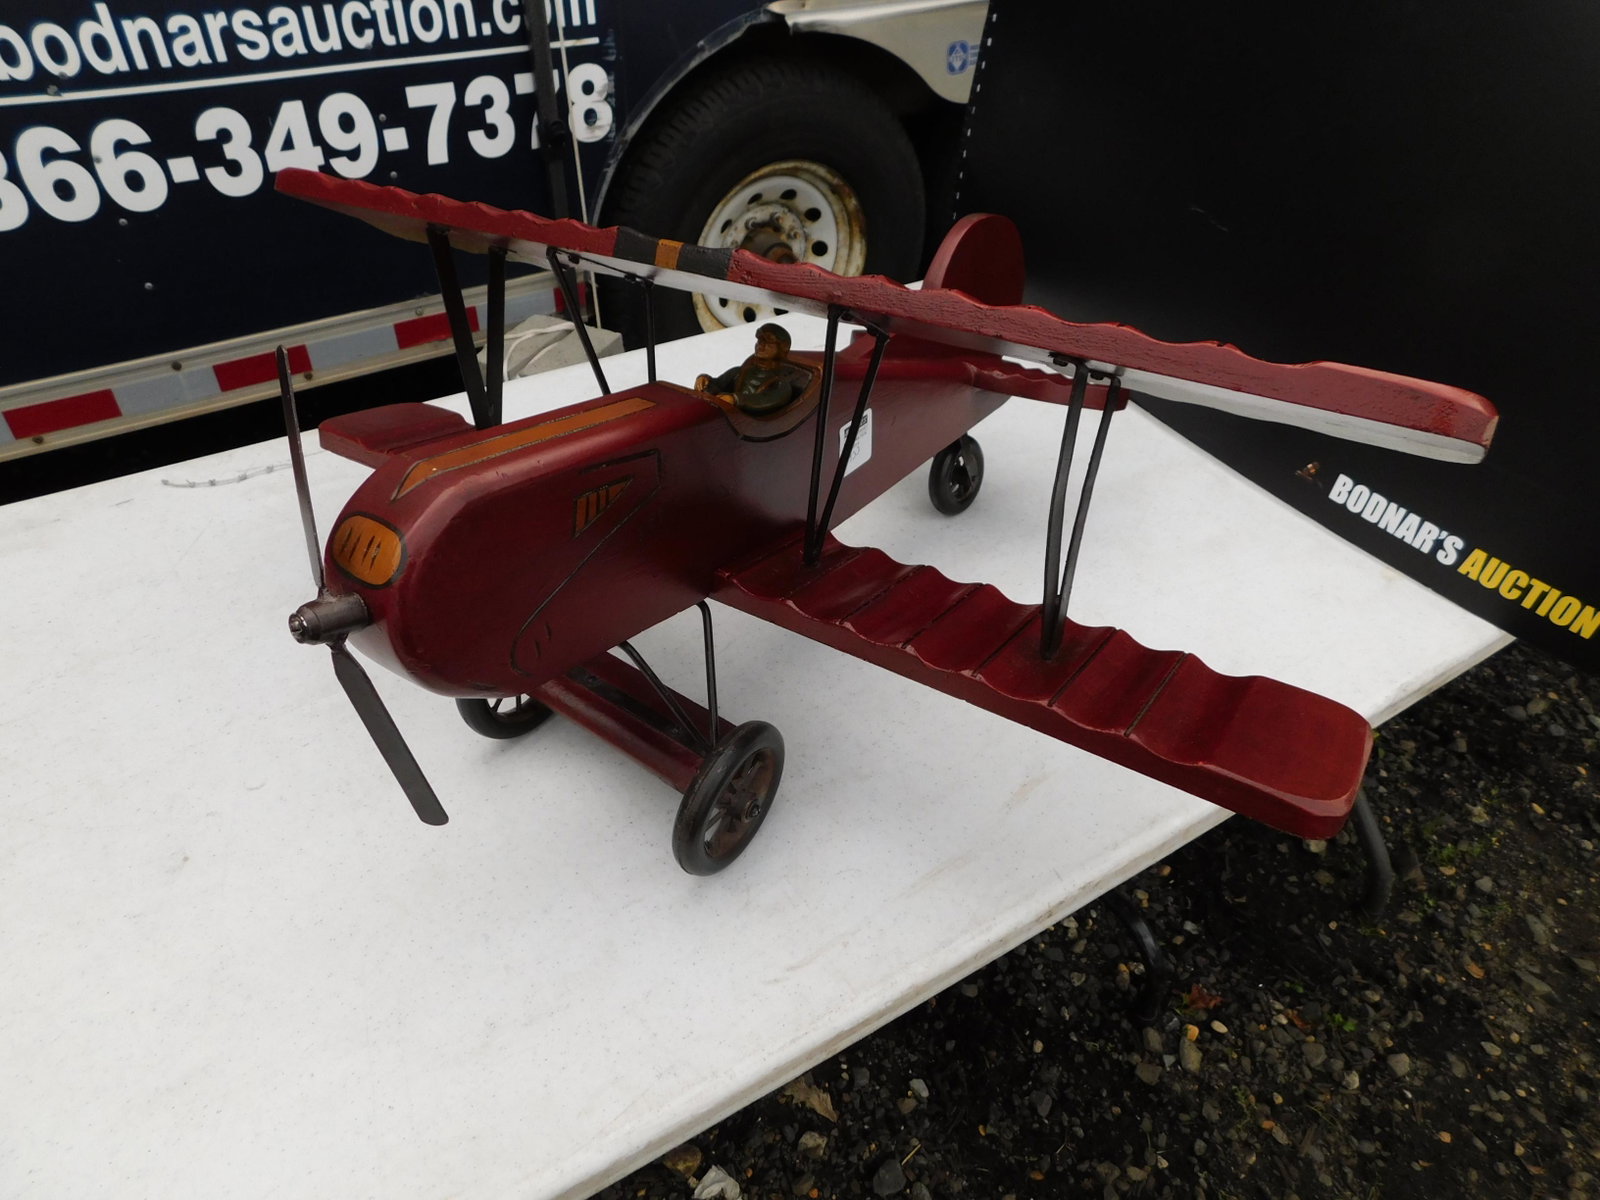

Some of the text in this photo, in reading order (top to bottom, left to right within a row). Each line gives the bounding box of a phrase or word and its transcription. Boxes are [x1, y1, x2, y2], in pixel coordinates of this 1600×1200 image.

[0, 0, 596, 81] bodnarsauction.cm
[1328, 473, 1600, 639] BODNAR'S AUCTION
